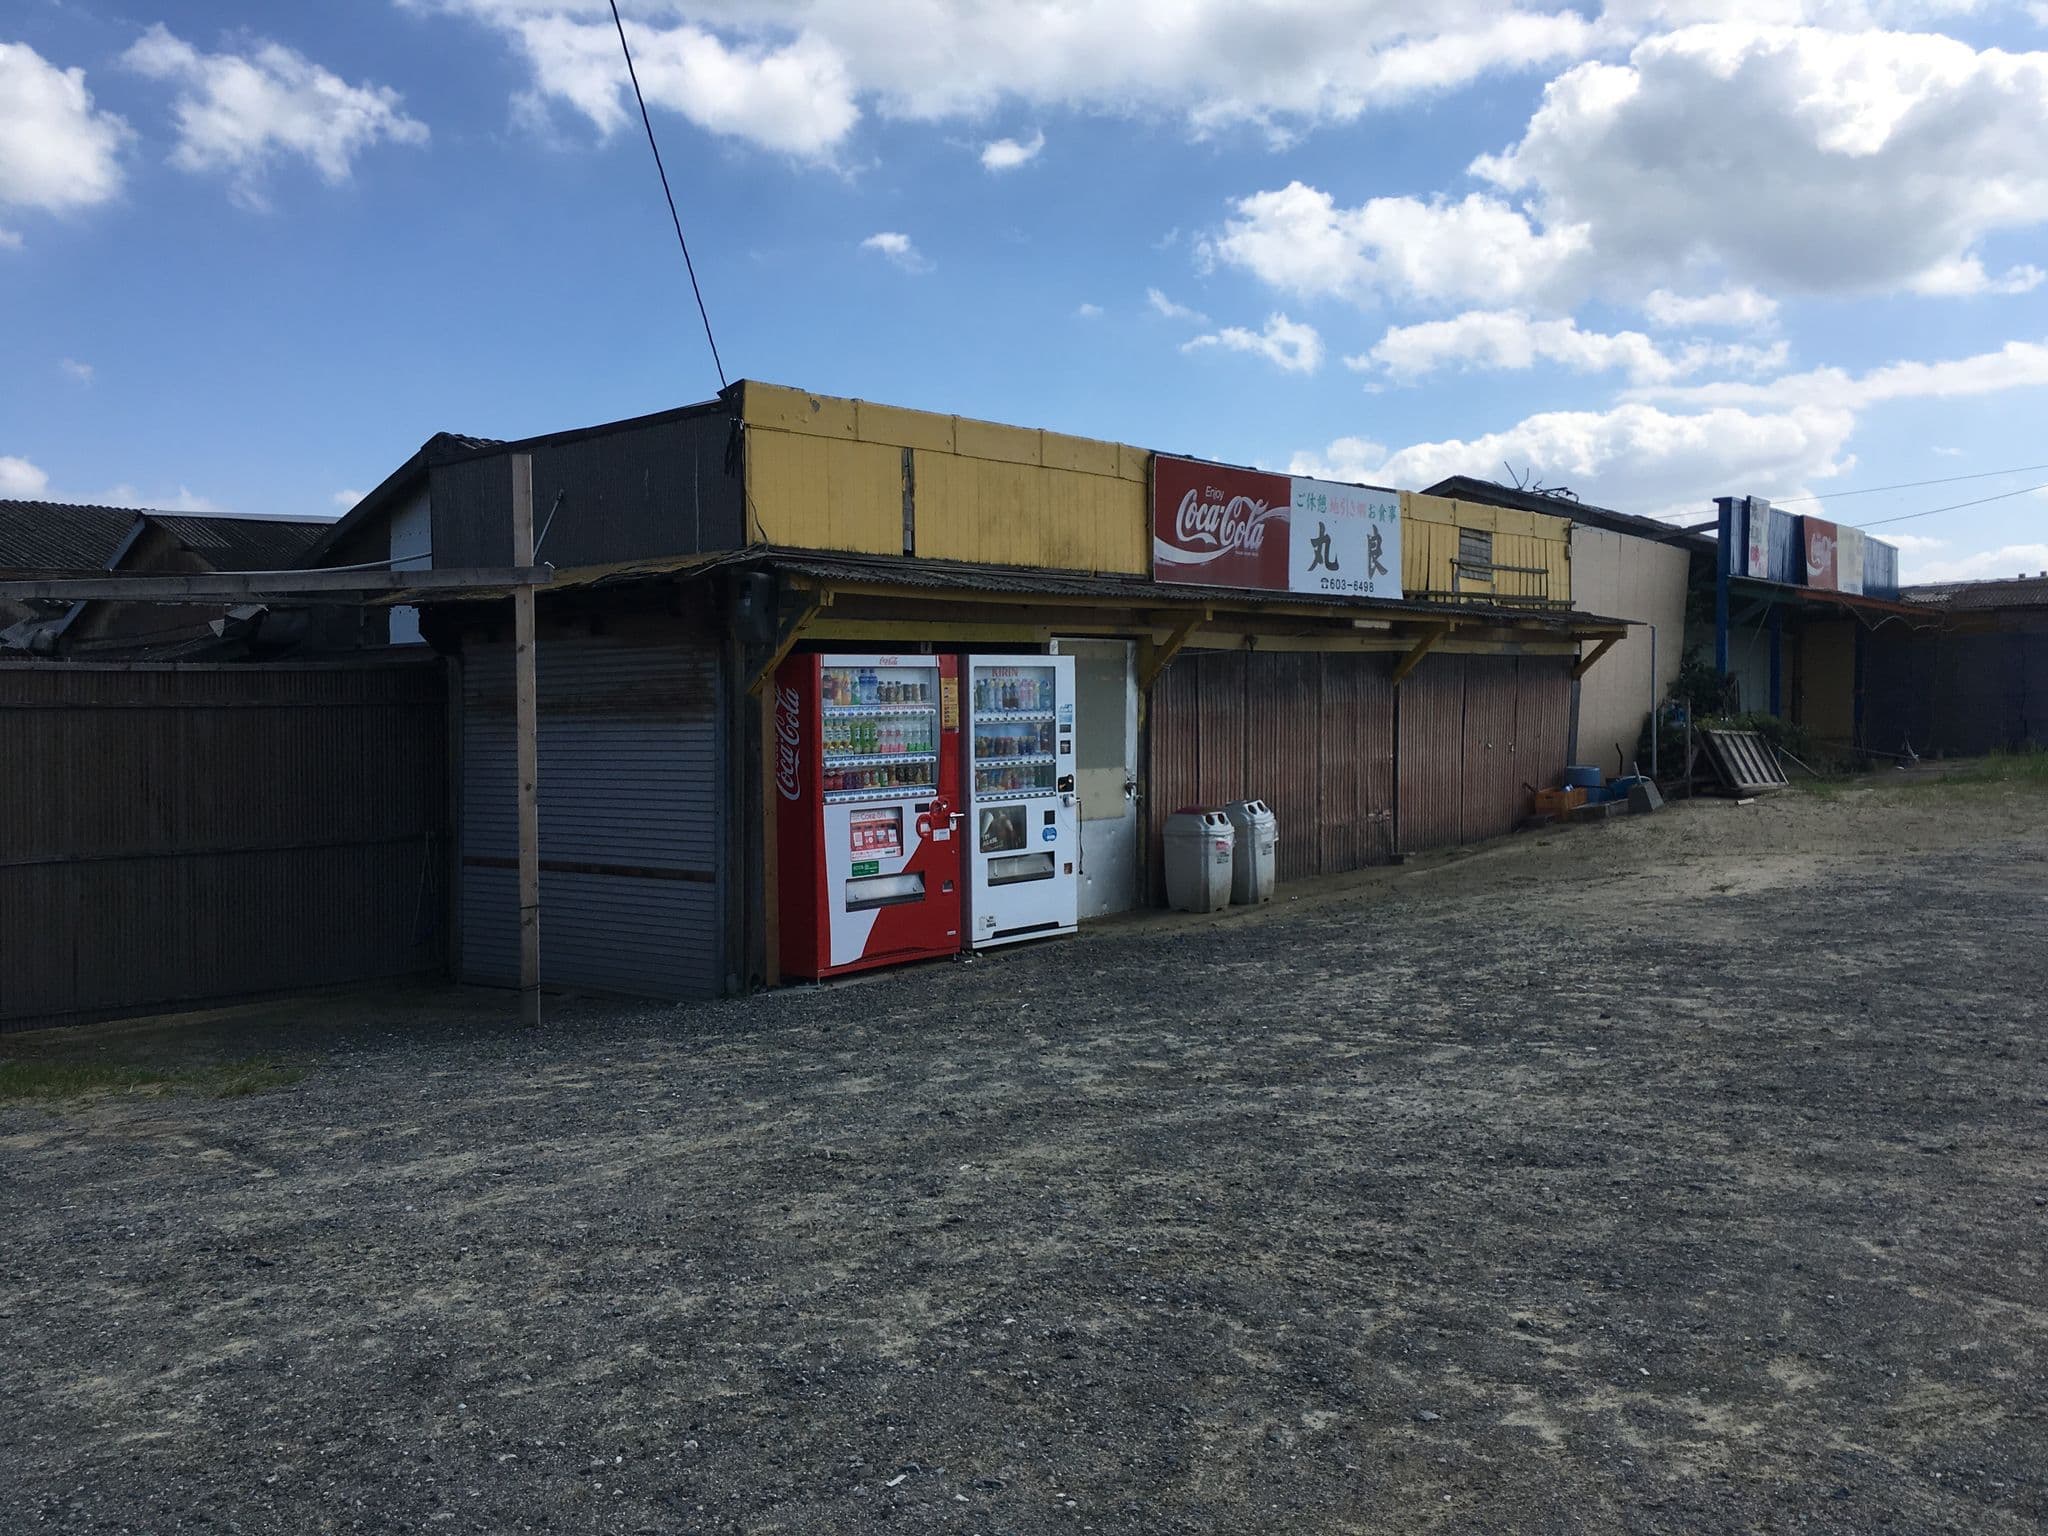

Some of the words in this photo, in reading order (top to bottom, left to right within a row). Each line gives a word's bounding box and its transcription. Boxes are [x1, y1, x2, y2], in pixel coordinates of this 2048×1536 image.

[1204, 486, 1225, 501] Enjoy
[1296, 492, 1327, 514] ご休憩
[1368, 503, 1397, 523] お食事
[1176, 488, 1269, 551] Coca-Cola
[1329, 577, 1375, 593] 603-6498
[991, 666, 1019, 677] KIRIN
[775, 683, 801, 801] Coca-Cola
